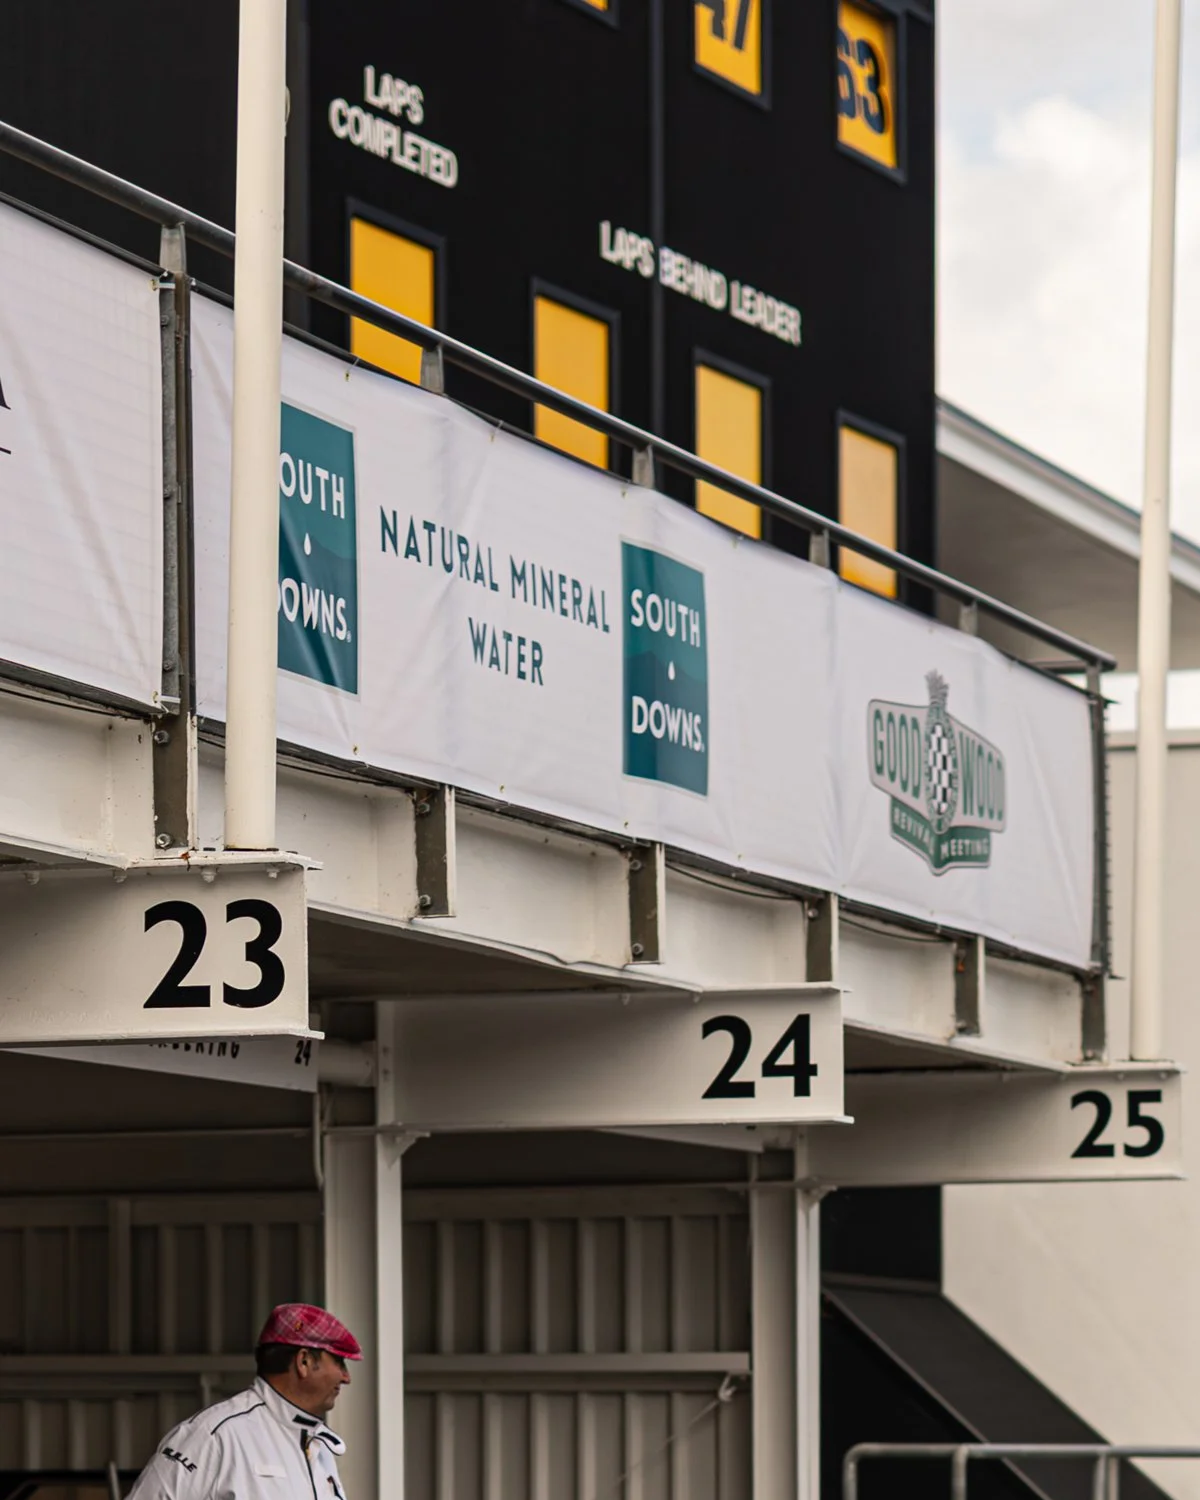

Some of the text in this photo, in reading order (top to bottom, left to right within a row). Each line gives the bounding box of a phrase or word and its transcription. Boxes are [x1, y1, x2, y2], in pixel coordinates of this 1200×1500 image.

[364, 64, 425, 125] LAPS
[328, 97, 459, 189] COMPLETED
[600, 219, 802, 347] LAPS BEHIND LEADER
[279, 452, 346, 519] OUTH
[379, 505, 611, 634] NATURAL MINERAL
[276, 577, 346, 641] OWNS
[630, 588, 701, 648] SOUTH
[467, 616, 545, 687] WATER
[631, 695, 703, 752] DOWNS
[873, 708, 922, 799] GOOD
[142, 898, 286, 1009] 23
[294, 1039, 313, 1067] 24
[700, 1012, 819, 1100] 24
[1069, 1088, 1165, 1160] 25
